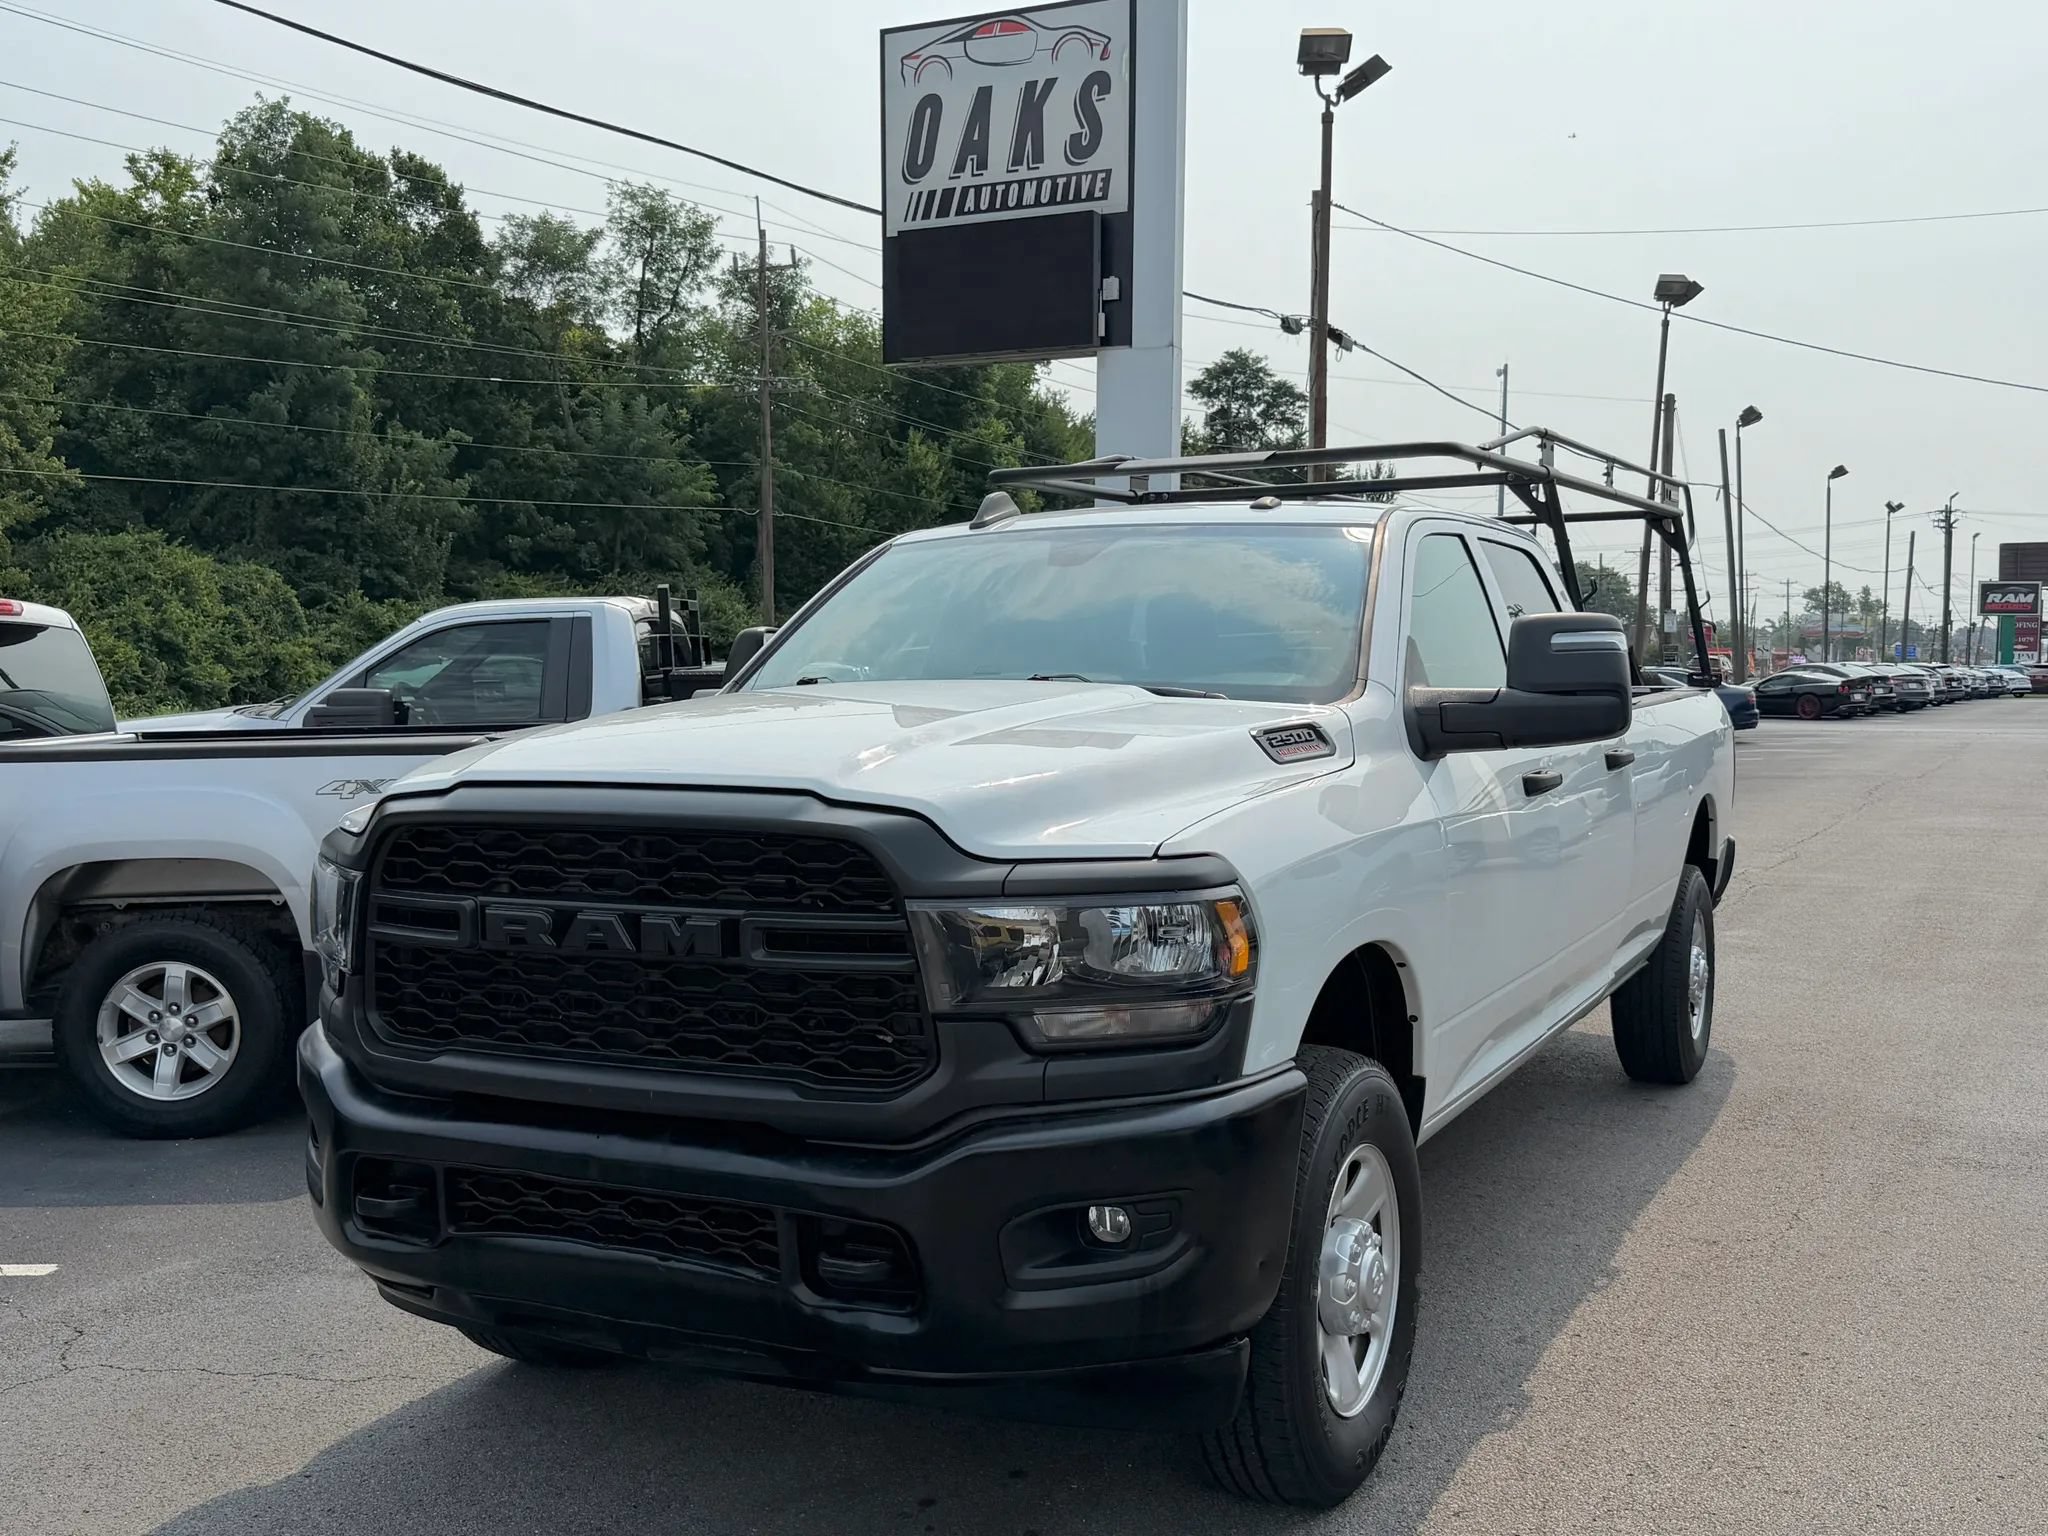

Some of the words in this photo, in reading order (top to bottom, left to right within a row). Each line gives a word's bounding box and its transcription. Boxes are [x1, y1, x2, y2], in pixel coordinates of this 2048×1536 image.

[901, 70, 1112, 185] OAKS
[963, 172, 1107, 213] AUTOMOTIVE
[1986, 592, 2036, 603] RAM
[1269, 729, 1317, 748] 2500
[315, 778, 398, 800] 4X
[484, 906, 724, 957] RAM
